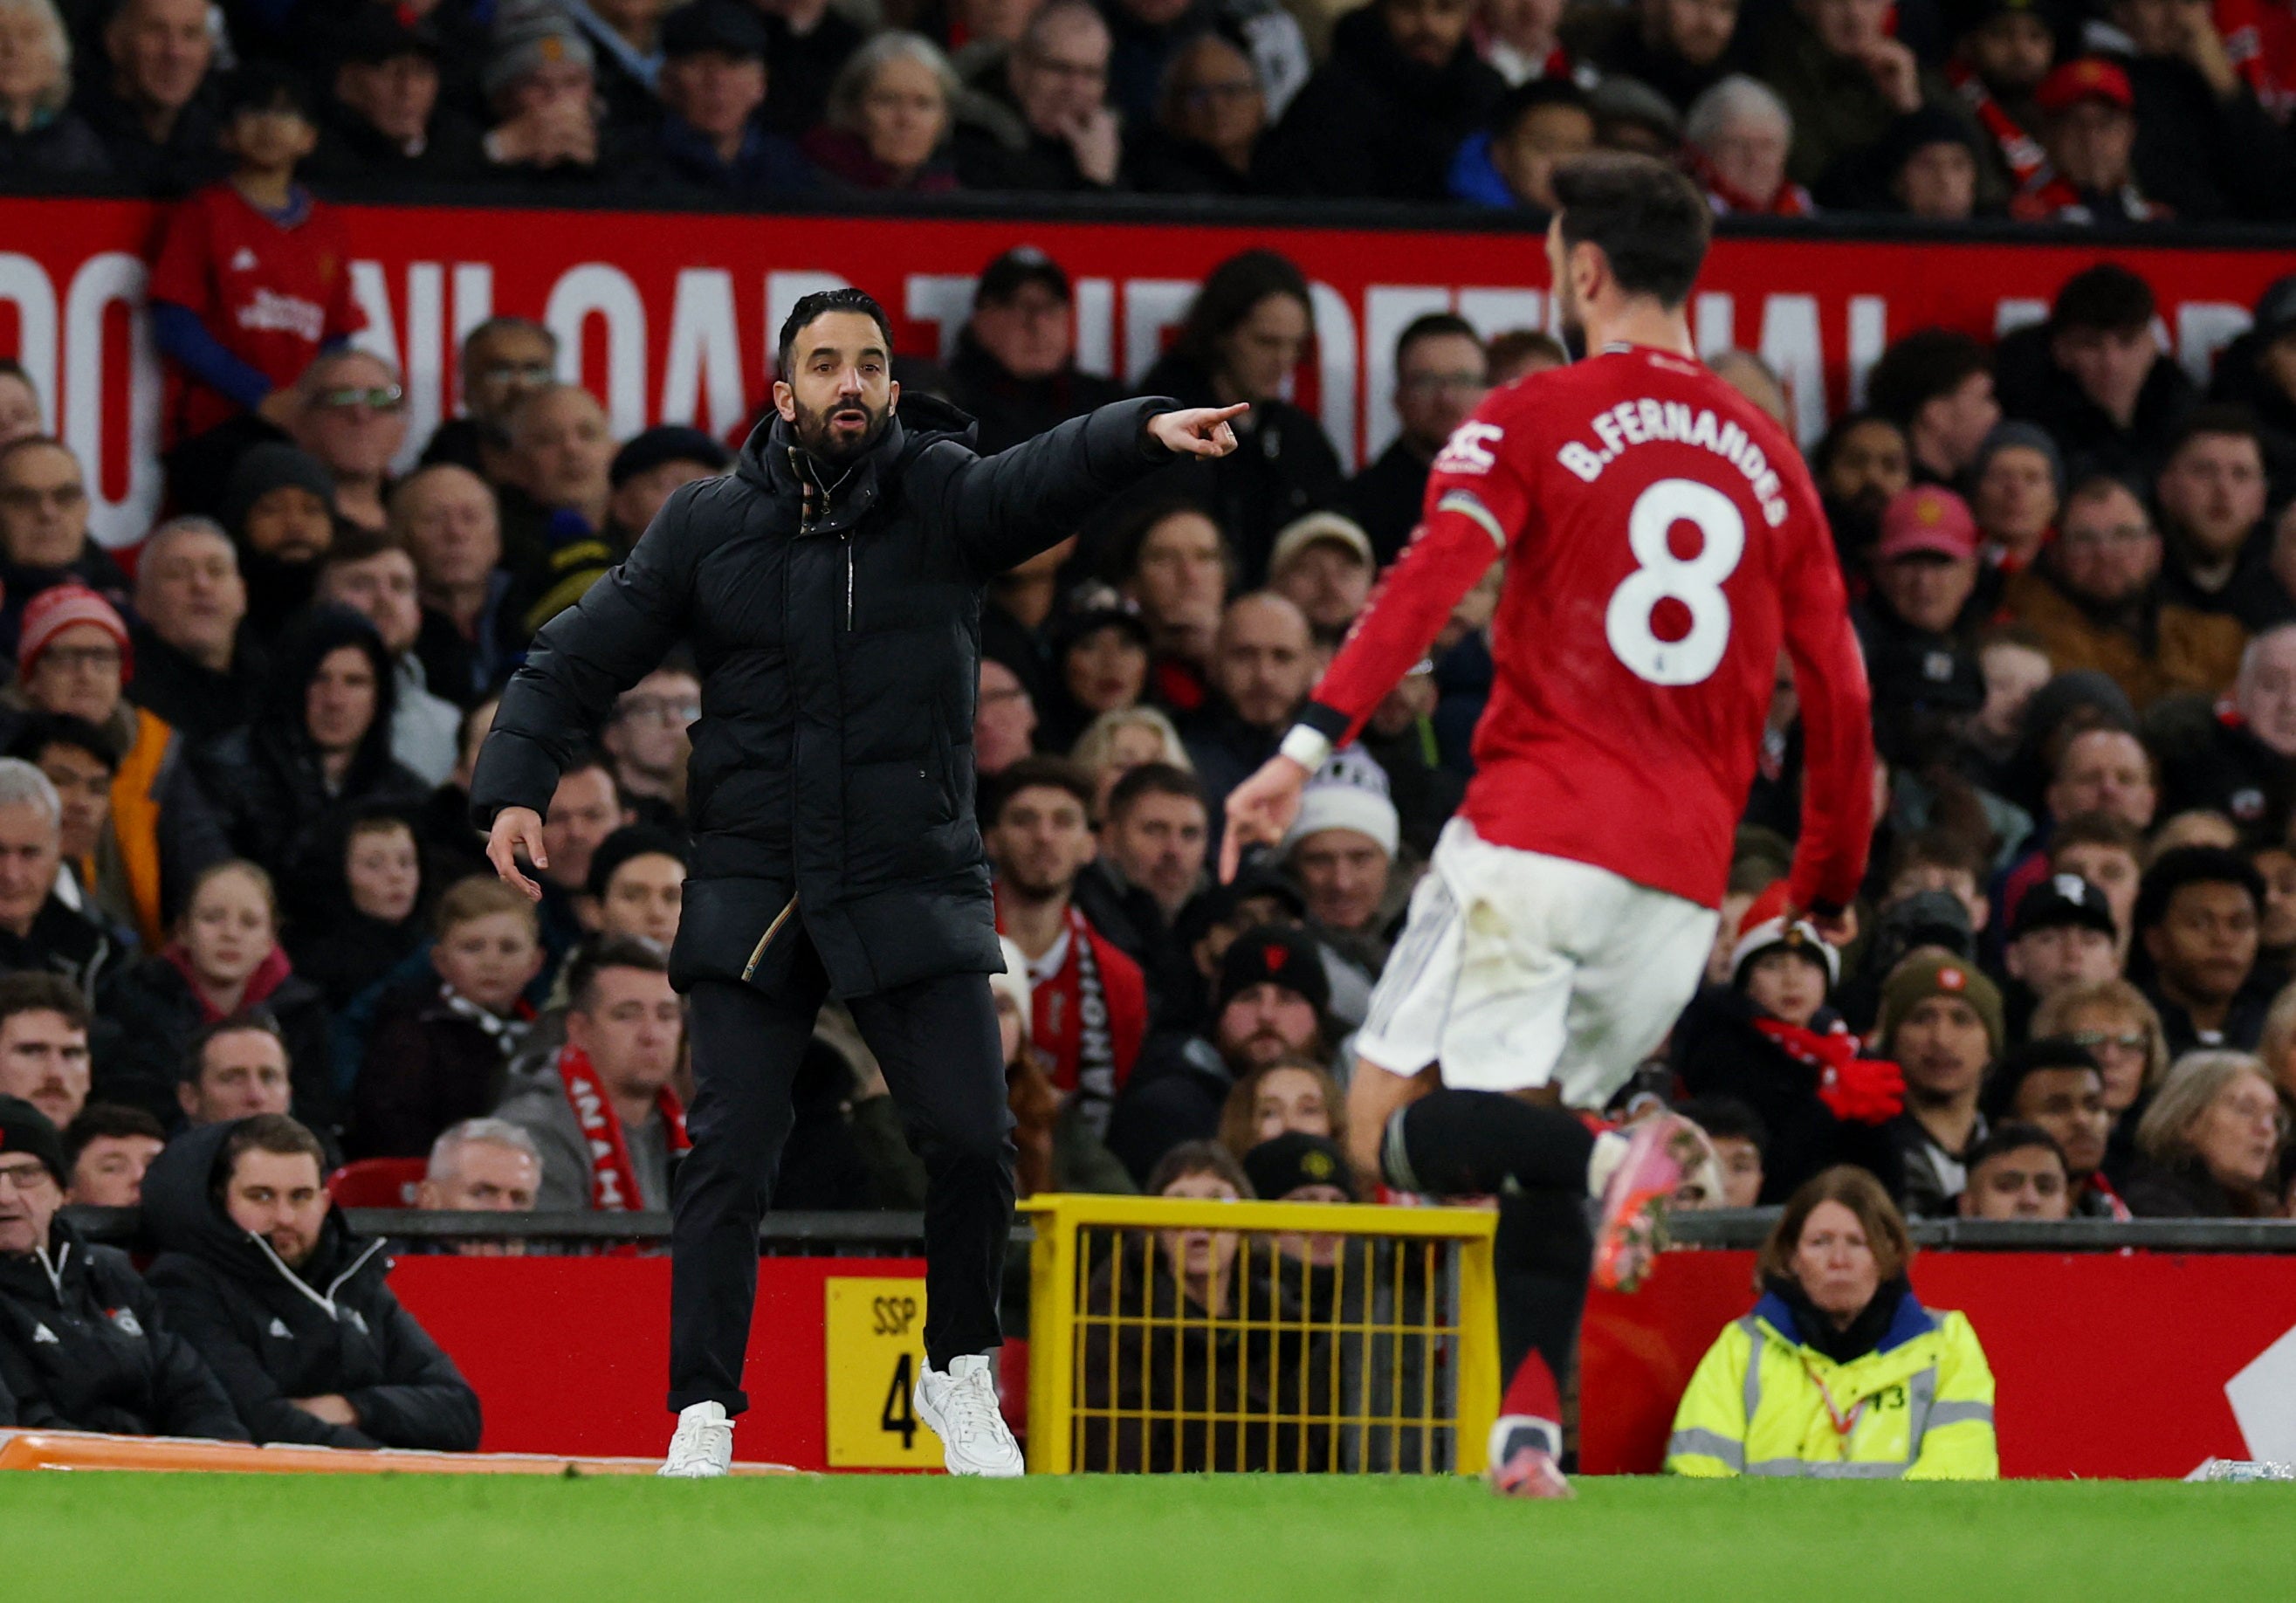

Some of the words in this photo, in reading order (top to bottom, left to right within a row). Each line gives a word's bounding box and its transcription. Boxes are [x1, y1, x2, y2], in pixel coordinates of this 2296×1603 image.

[1557, 397, 1789, 527] B.FERNANDES
[1605, 478, 1745, 686] 8
[872, 1296, 917, 1335] SSP
[881, 1352, 917, 1449] 4
